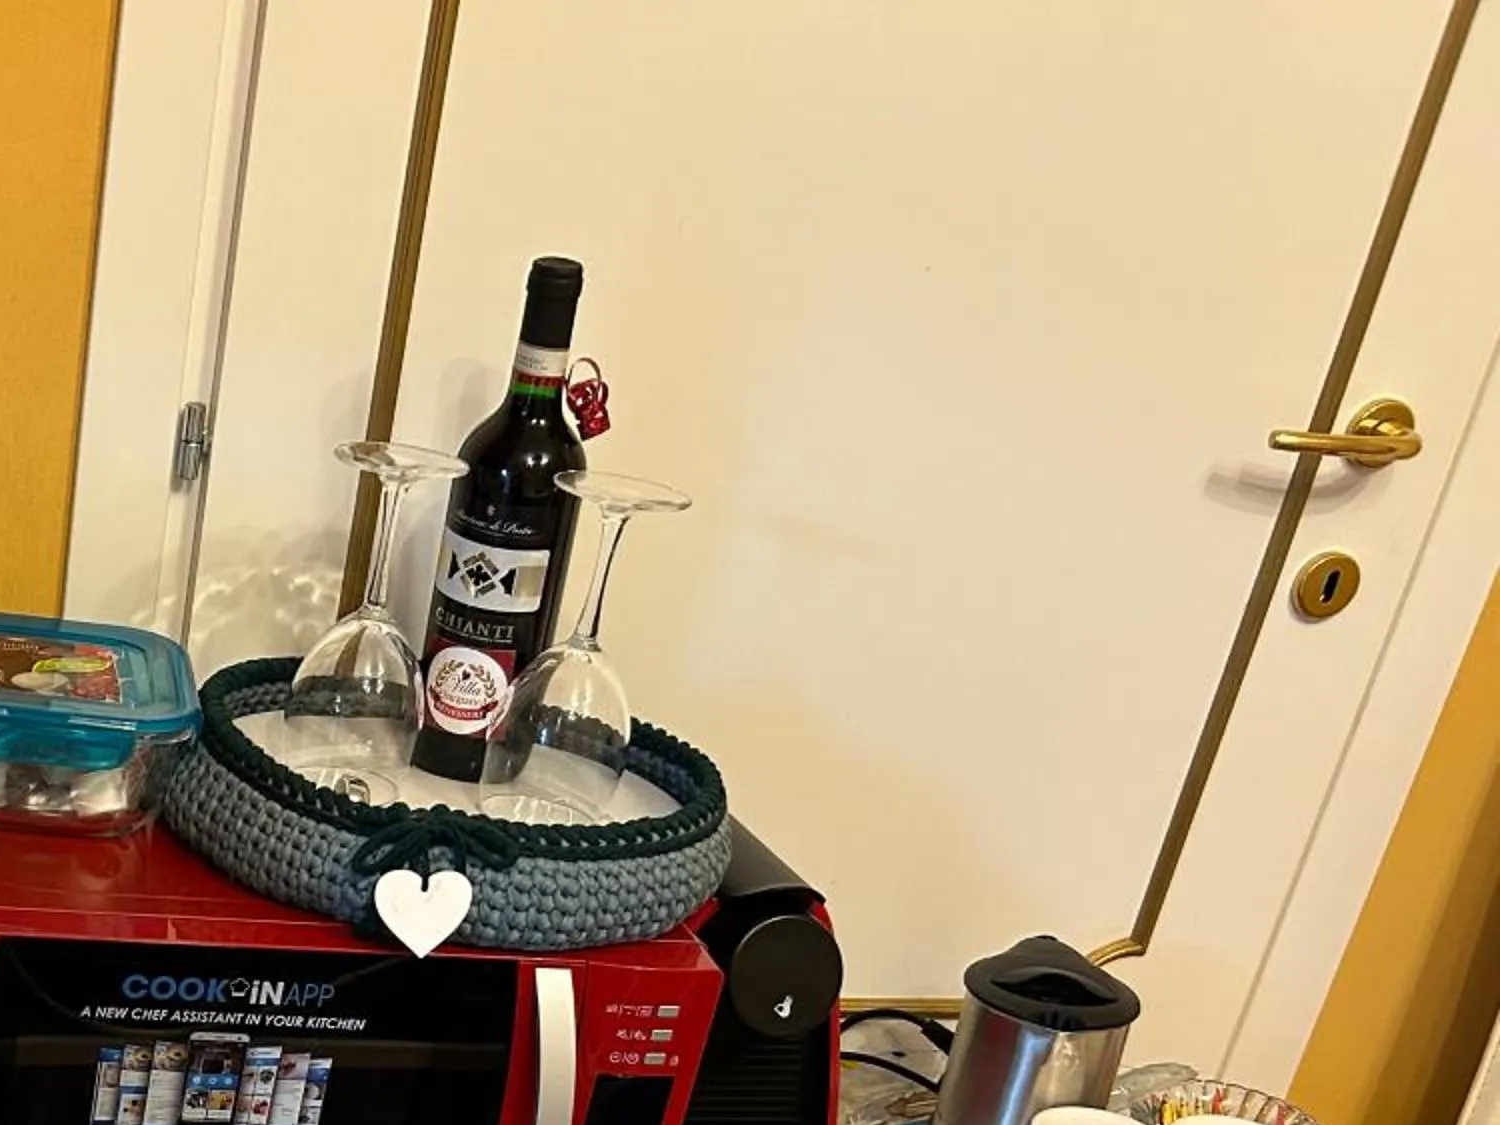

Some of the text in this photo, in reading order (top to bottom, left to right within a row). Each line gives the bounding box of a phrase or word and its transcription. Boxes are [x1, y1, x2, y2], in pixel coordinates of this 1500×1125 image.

[435, 606, 516, 640] CHIANTI
[121, 974, 229, 1002] COOK
[79, 1006, 368, 1032] A NEW CHEF ASSISTANT IN YOUR KITCHEN
